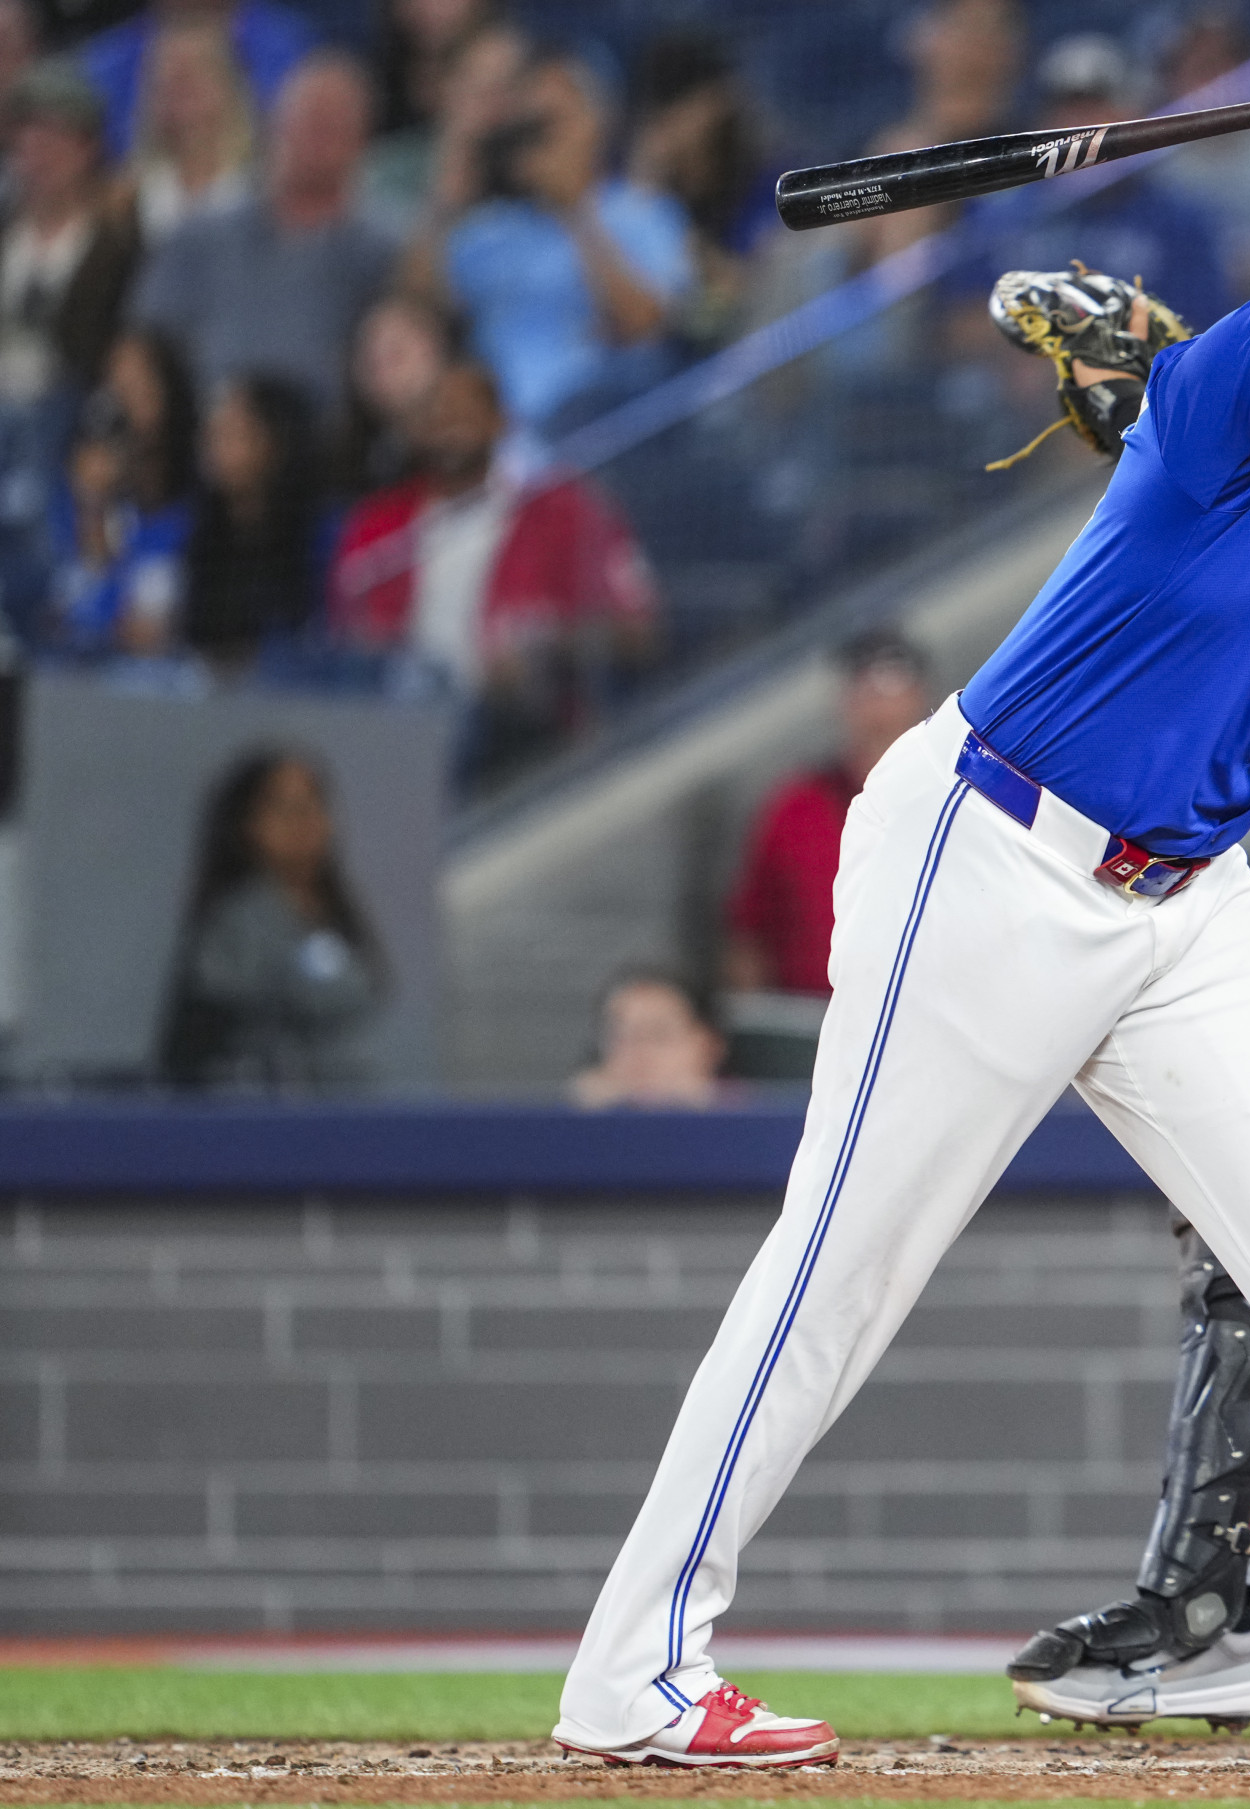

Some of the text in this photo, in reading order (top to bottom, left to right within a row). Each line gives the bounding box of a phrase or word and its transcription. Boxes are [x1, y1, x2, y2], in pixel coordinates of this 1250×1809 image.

[1030, 129, 1096, 157] marucci
[820, 192, 843, 203] Model
[843, 189, 856, 197] Pro
[816, 193, 892, 215] Vladimir Guerrero Jr.
[845, 205, 884, 217] Handcrafted
